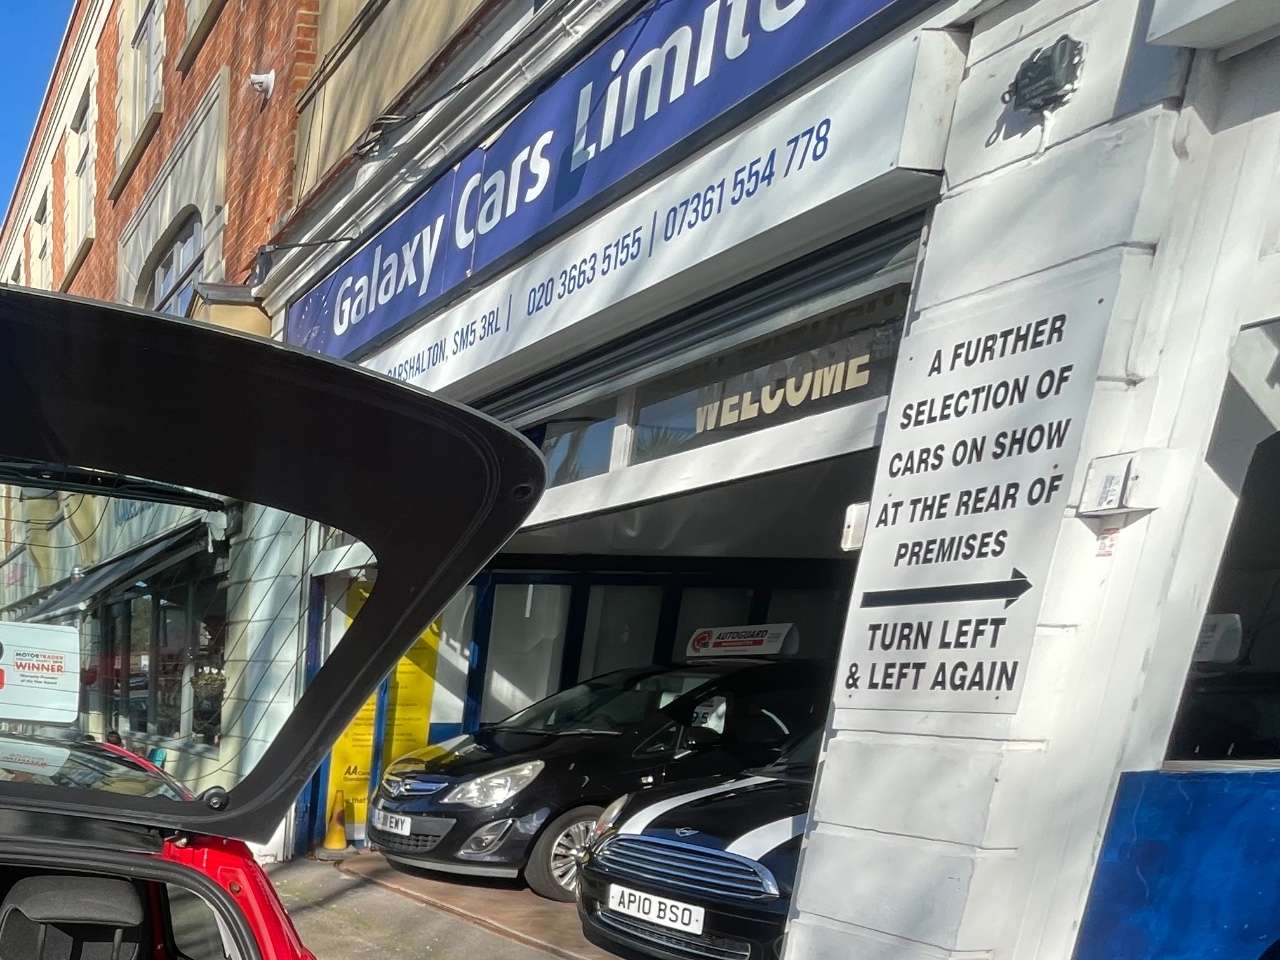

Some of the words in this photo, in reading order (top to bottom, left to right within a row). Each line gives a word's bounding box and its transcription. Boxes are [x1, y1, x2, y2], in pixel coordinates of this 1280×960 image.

[333, 214, 445, 336] Galaxy
[455, 130, 554, 250] Cars
[452, 320, 477, 355] SM5
[479, 307, 501, 341] 3RL
[527, 277, 554, 316] 020
[557, 253, 597, 301] 3663
[601, 226, 643, 276] 5155
[664, 178, 726, 242] 07361
[731, 148, 777, 205] 554
[783, 118, 832, 178] 778
[928, 349, 943, 377] A
[949, 314, 1067, 372] FURTHER
[695, 341, 870, 433] WELCOME
[899, 378, 1026, 430] SELECTION
[1036, 365, 1073, 397] OF
[888, 446, 944, 478] CARS
[952, 436, 987, 465] ON
[991, 418, 1072, 459] SHOW
[875, 499, 903, 528] AT
[908, 491, 948, 523] THE
[956, 481, 1020, 516] REAR
[1028, 474, 1064, 507] OF
[893, 530, 1008, 567] PREMISES
[867, 621, 931, 651] TURN
[938, 617, 1007, 649] LEFT
[15, 662, 64, 673] WINNER
[844, 661, 860, 690] &
[867, 662, 925, 690] LEFT
[930, 660, 1018, 692] AGAIN
[618, 890, 652, 915] AP10
[657, 901, 692, 926] BSO
